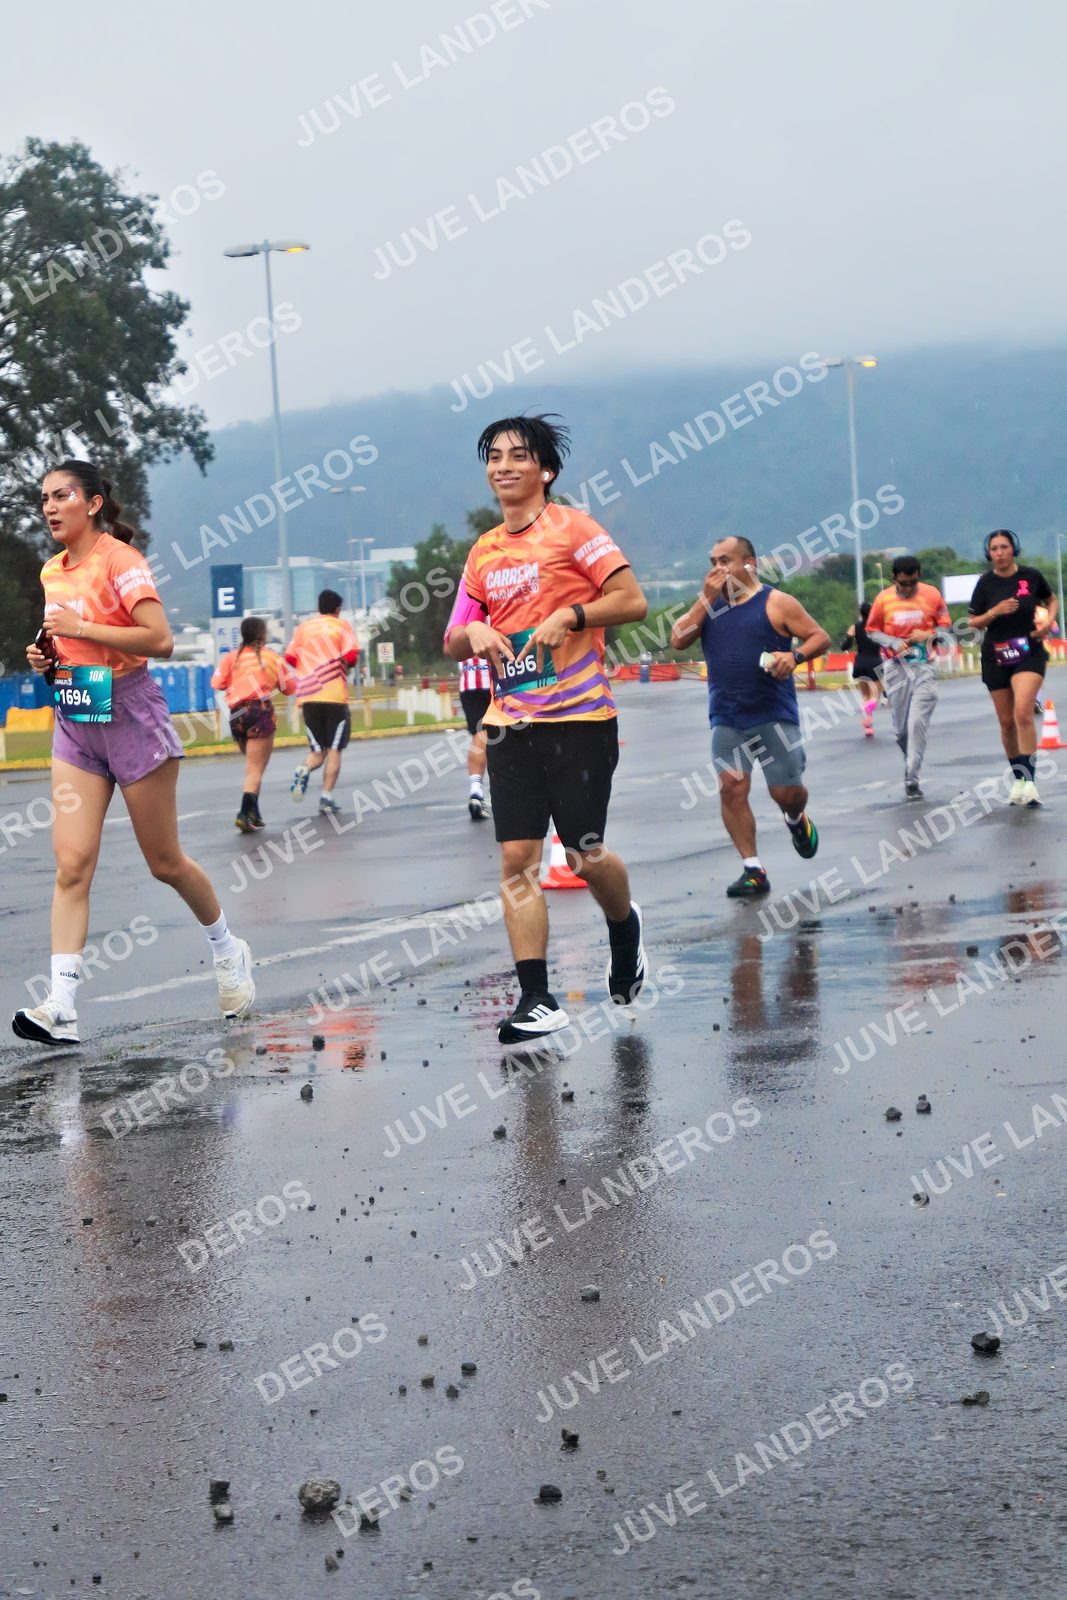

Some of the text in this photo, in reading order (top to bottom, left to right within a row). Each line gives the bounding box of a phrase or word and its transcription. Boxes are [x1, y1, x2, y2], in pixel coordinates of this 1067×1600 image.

[486, 561, 539, 589] CARRERA
[217, 587, 236, 611] E
[89, 670, 105, 683] 10K
[502, 654, 537, 679] 1696
[59, 688, 91, 706] 1694
